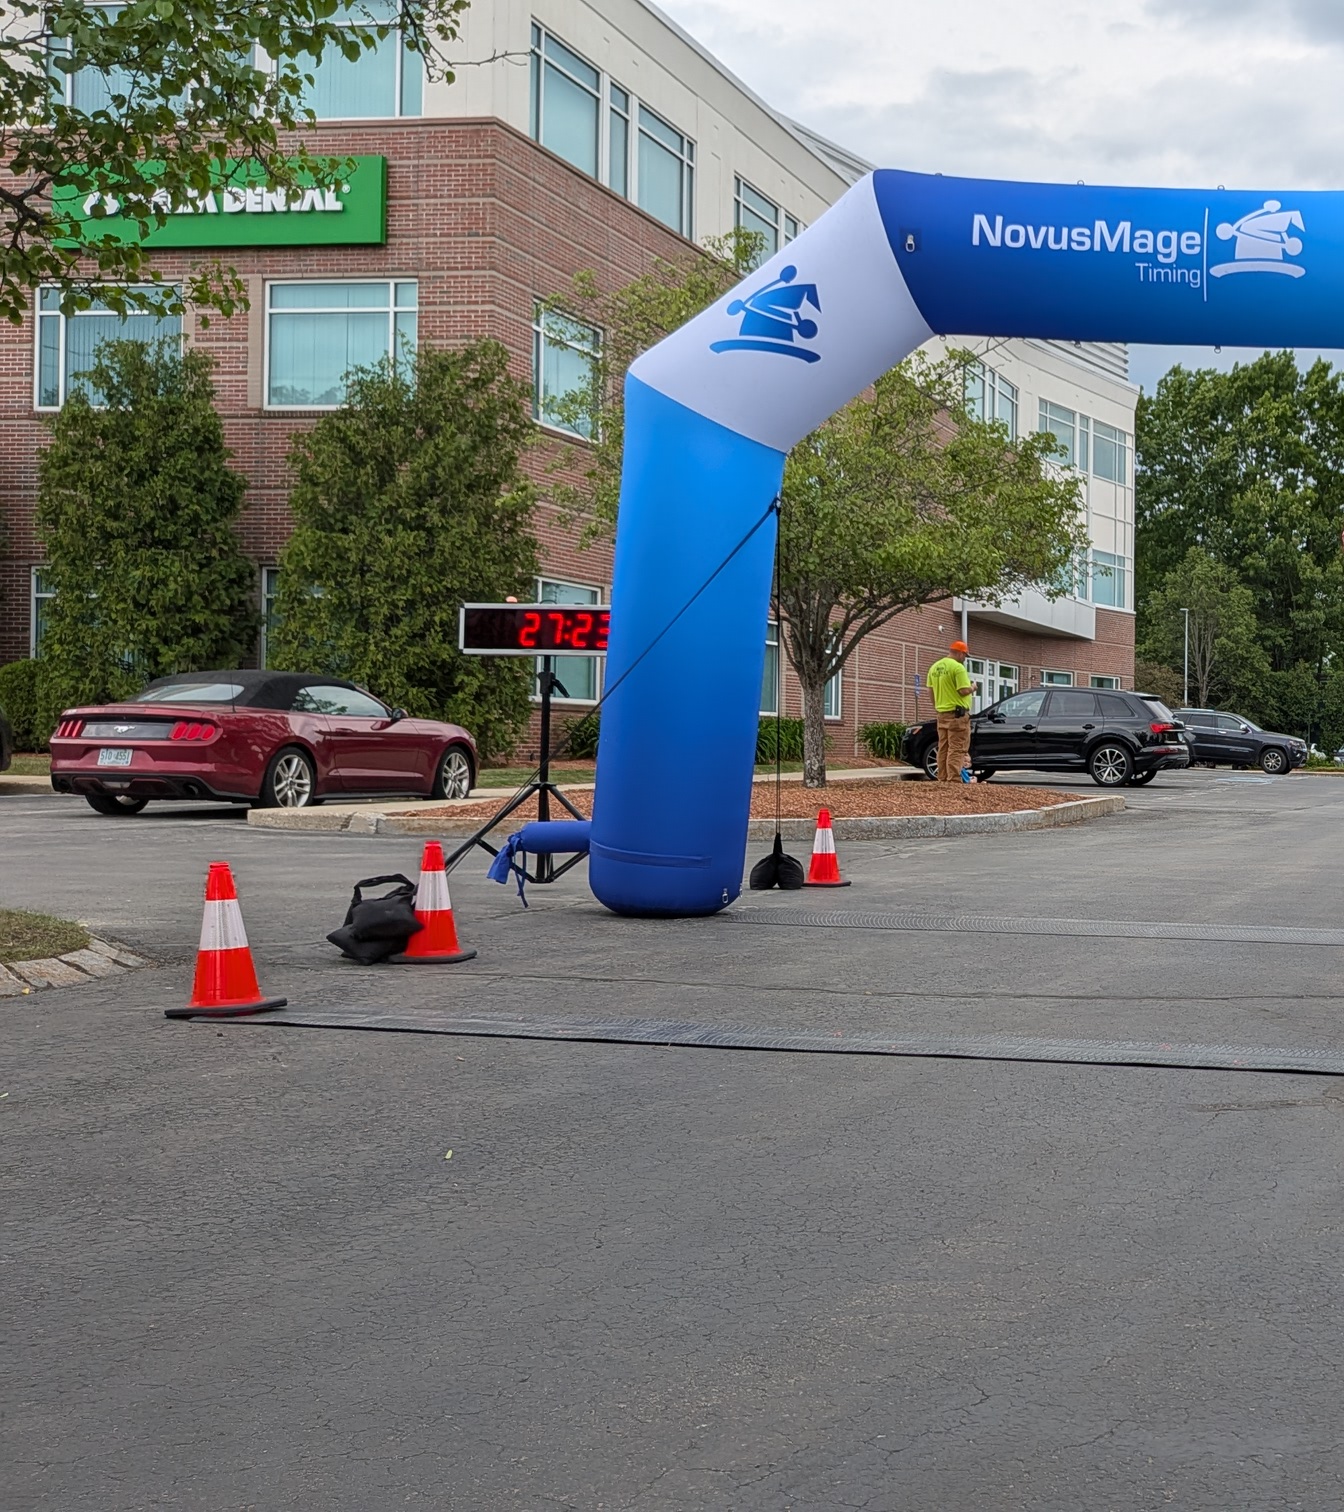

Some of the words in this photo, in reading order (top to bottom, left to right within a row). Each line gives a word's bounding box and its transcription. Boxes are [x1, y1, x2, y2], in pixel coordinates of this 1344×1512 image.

[128, 186, 219, 213] ETA
[972, 213, 1201, 263] NovusMage
[1135, 262, 1201, 288] Timing
